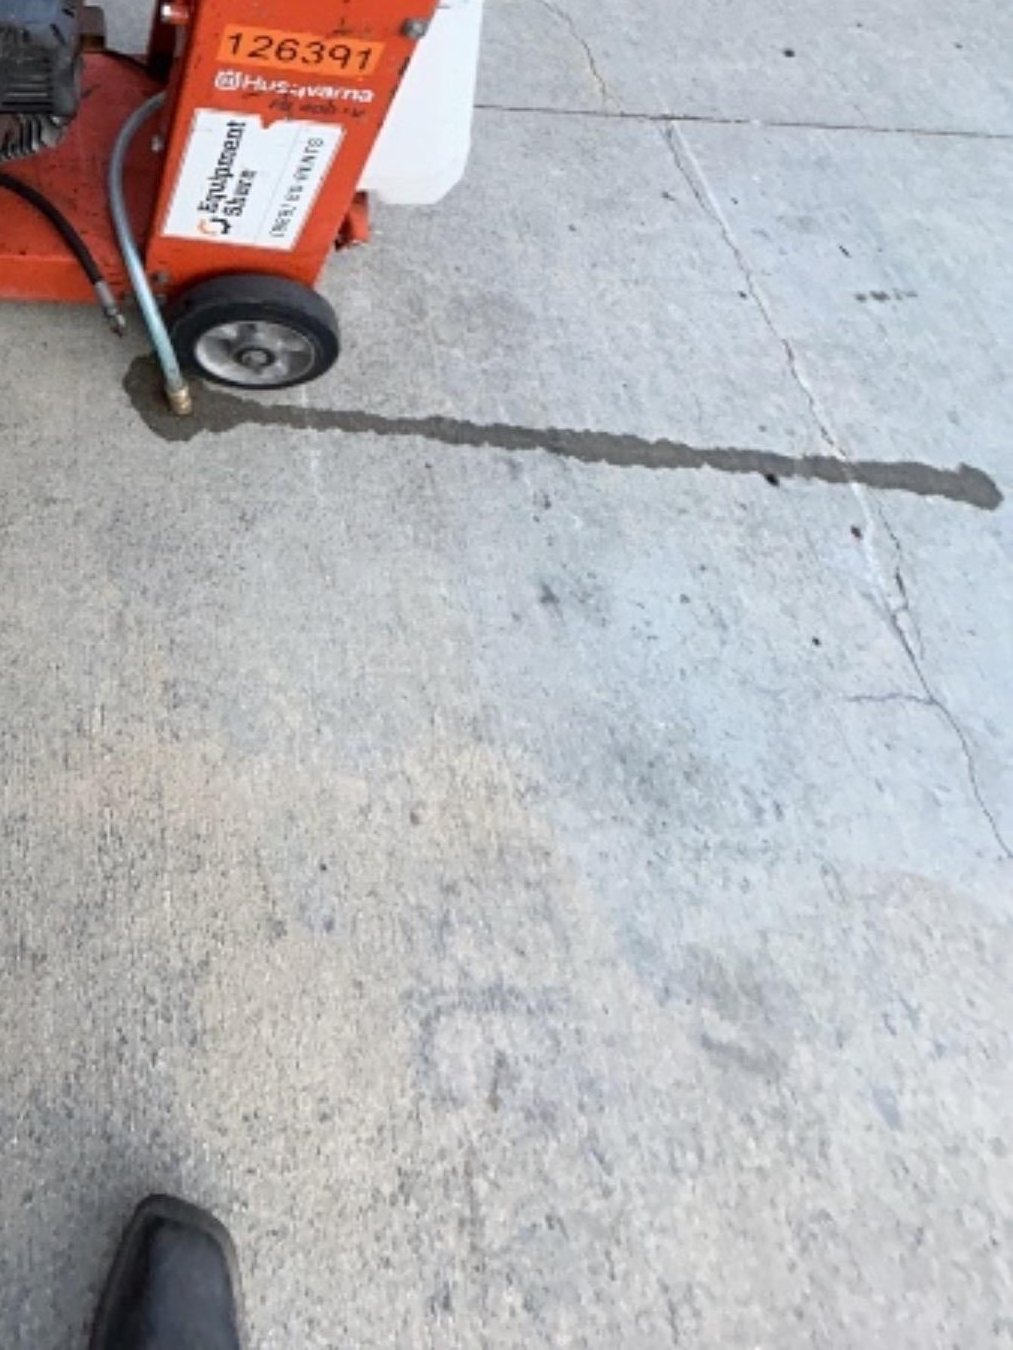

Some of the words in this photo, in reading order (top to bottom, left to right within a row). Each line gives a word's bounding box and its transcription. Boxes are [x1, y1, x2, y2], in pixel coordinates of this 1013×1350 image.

[227, 32, 373, 71] 126391
[195, 119, 247, 213] Equipment
[222, 168, 257, 217] Share
